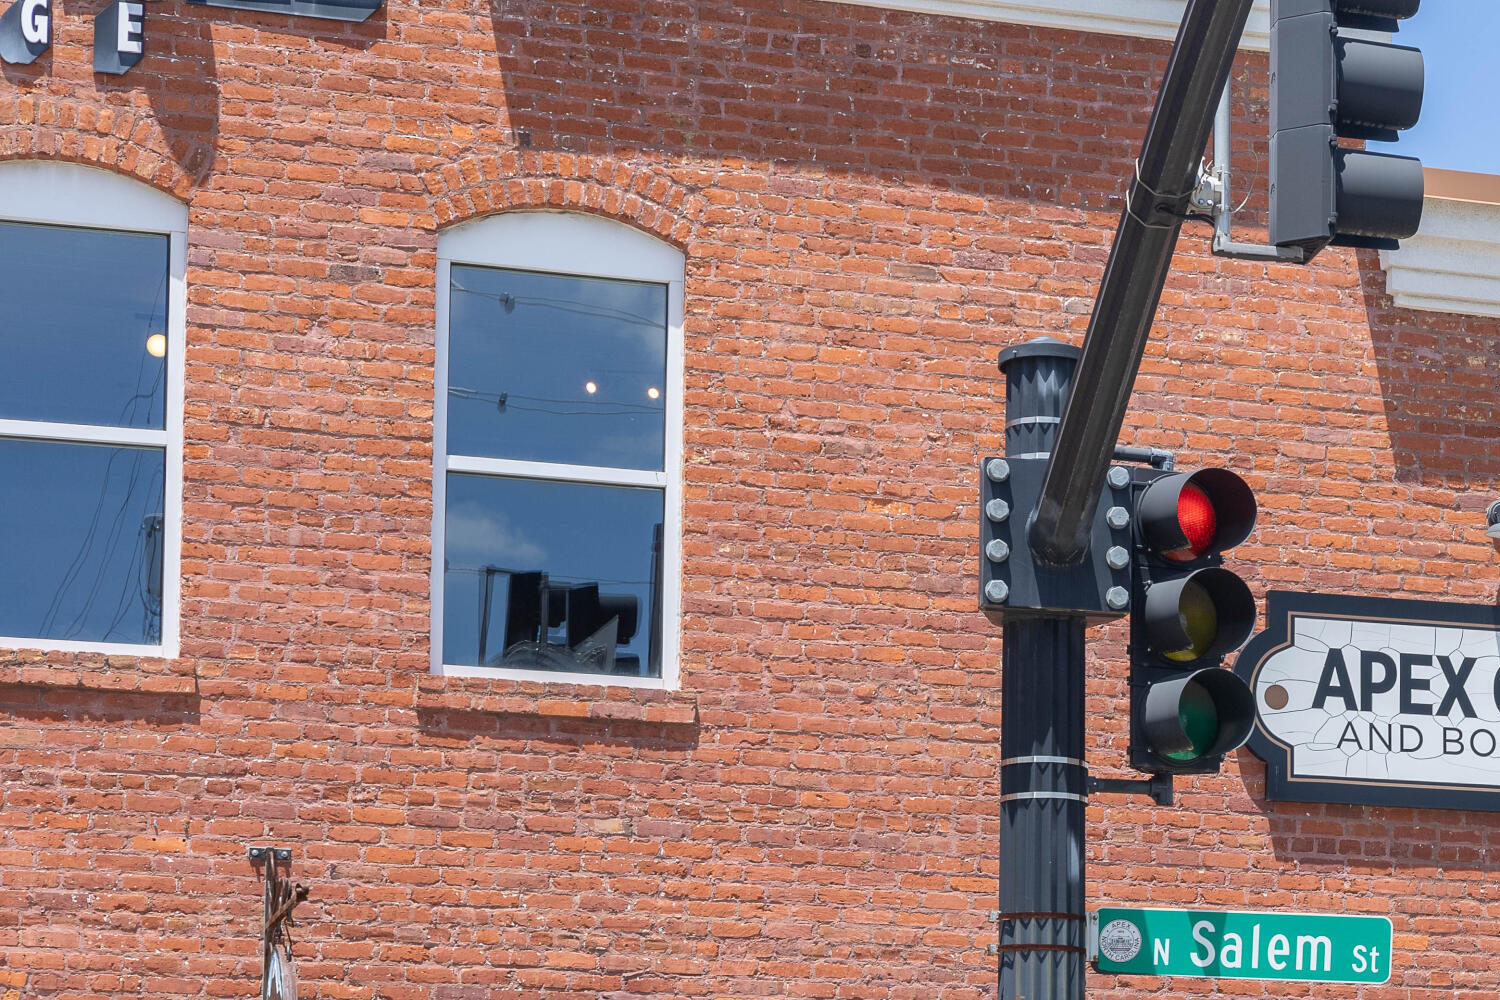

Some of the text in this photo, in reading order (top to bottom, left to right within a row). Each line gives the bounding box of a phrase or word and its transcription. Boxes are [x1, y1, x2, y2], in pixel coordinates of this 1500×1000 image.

[1312, 647, 1478, 719] APEX
[1336, 720, 1424, 753] AND
[1153, 920, 1380, 974] N Salem St
